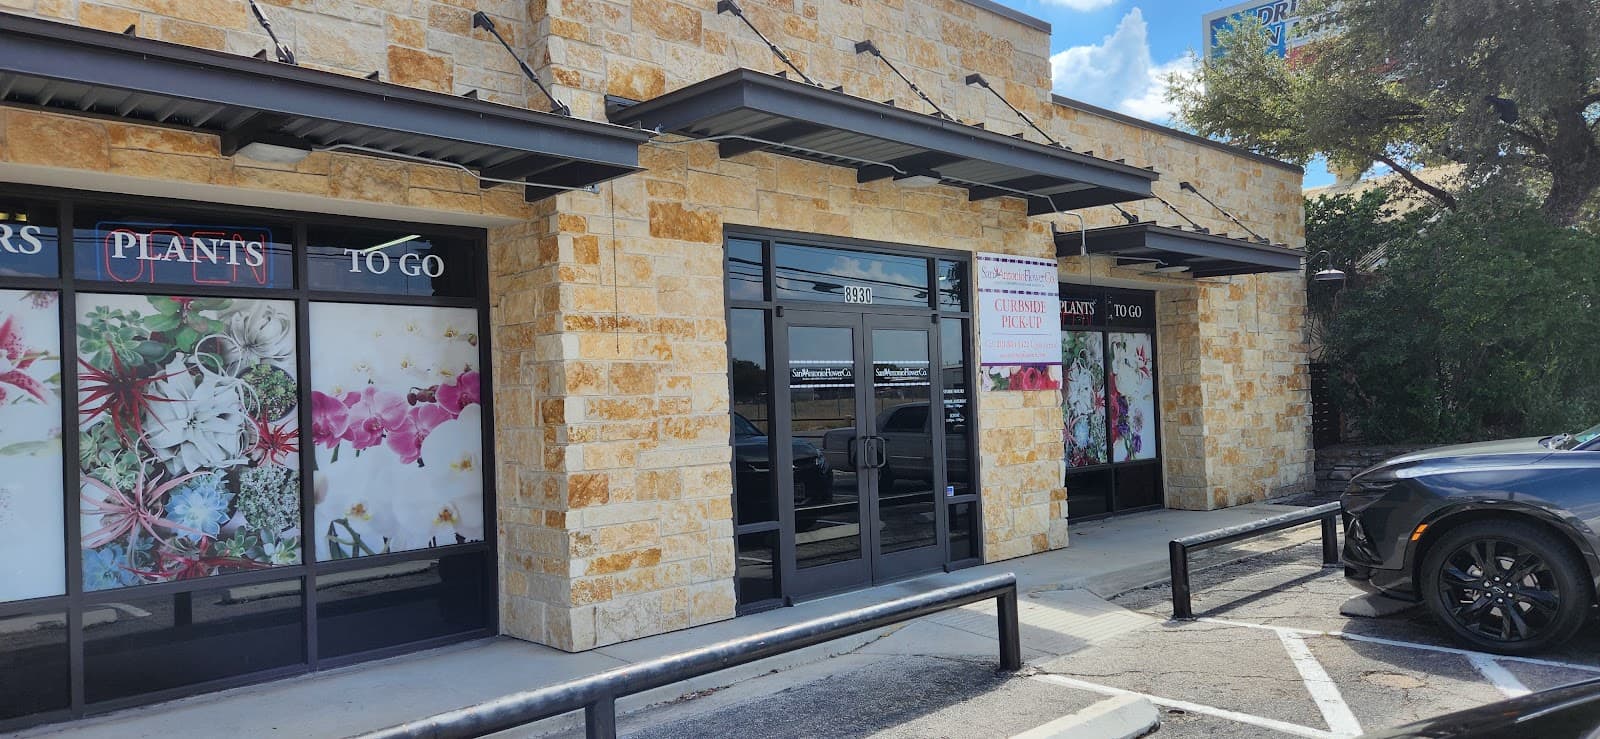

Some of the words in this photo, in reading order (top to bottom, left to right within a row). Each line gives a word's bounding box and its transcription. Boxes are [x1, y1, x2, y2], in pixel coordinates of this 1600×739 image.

[104, 228, 267, 285] OPEN
[110, 231, 264, 267] PLANTS
[343, 248, 390, 274] TO
[399, 252, 445, 278] GO
[845, 286, 871, 303] 8930
[994, 299, 1046, 314] CURBSIDE
[1060, 300, 1095, 316] PLANTS
[1113, 303, 1127, 318] TO
[1128, 304, 1142, 319] GO
[1002, 315, 1042, 329] PICK-UP
